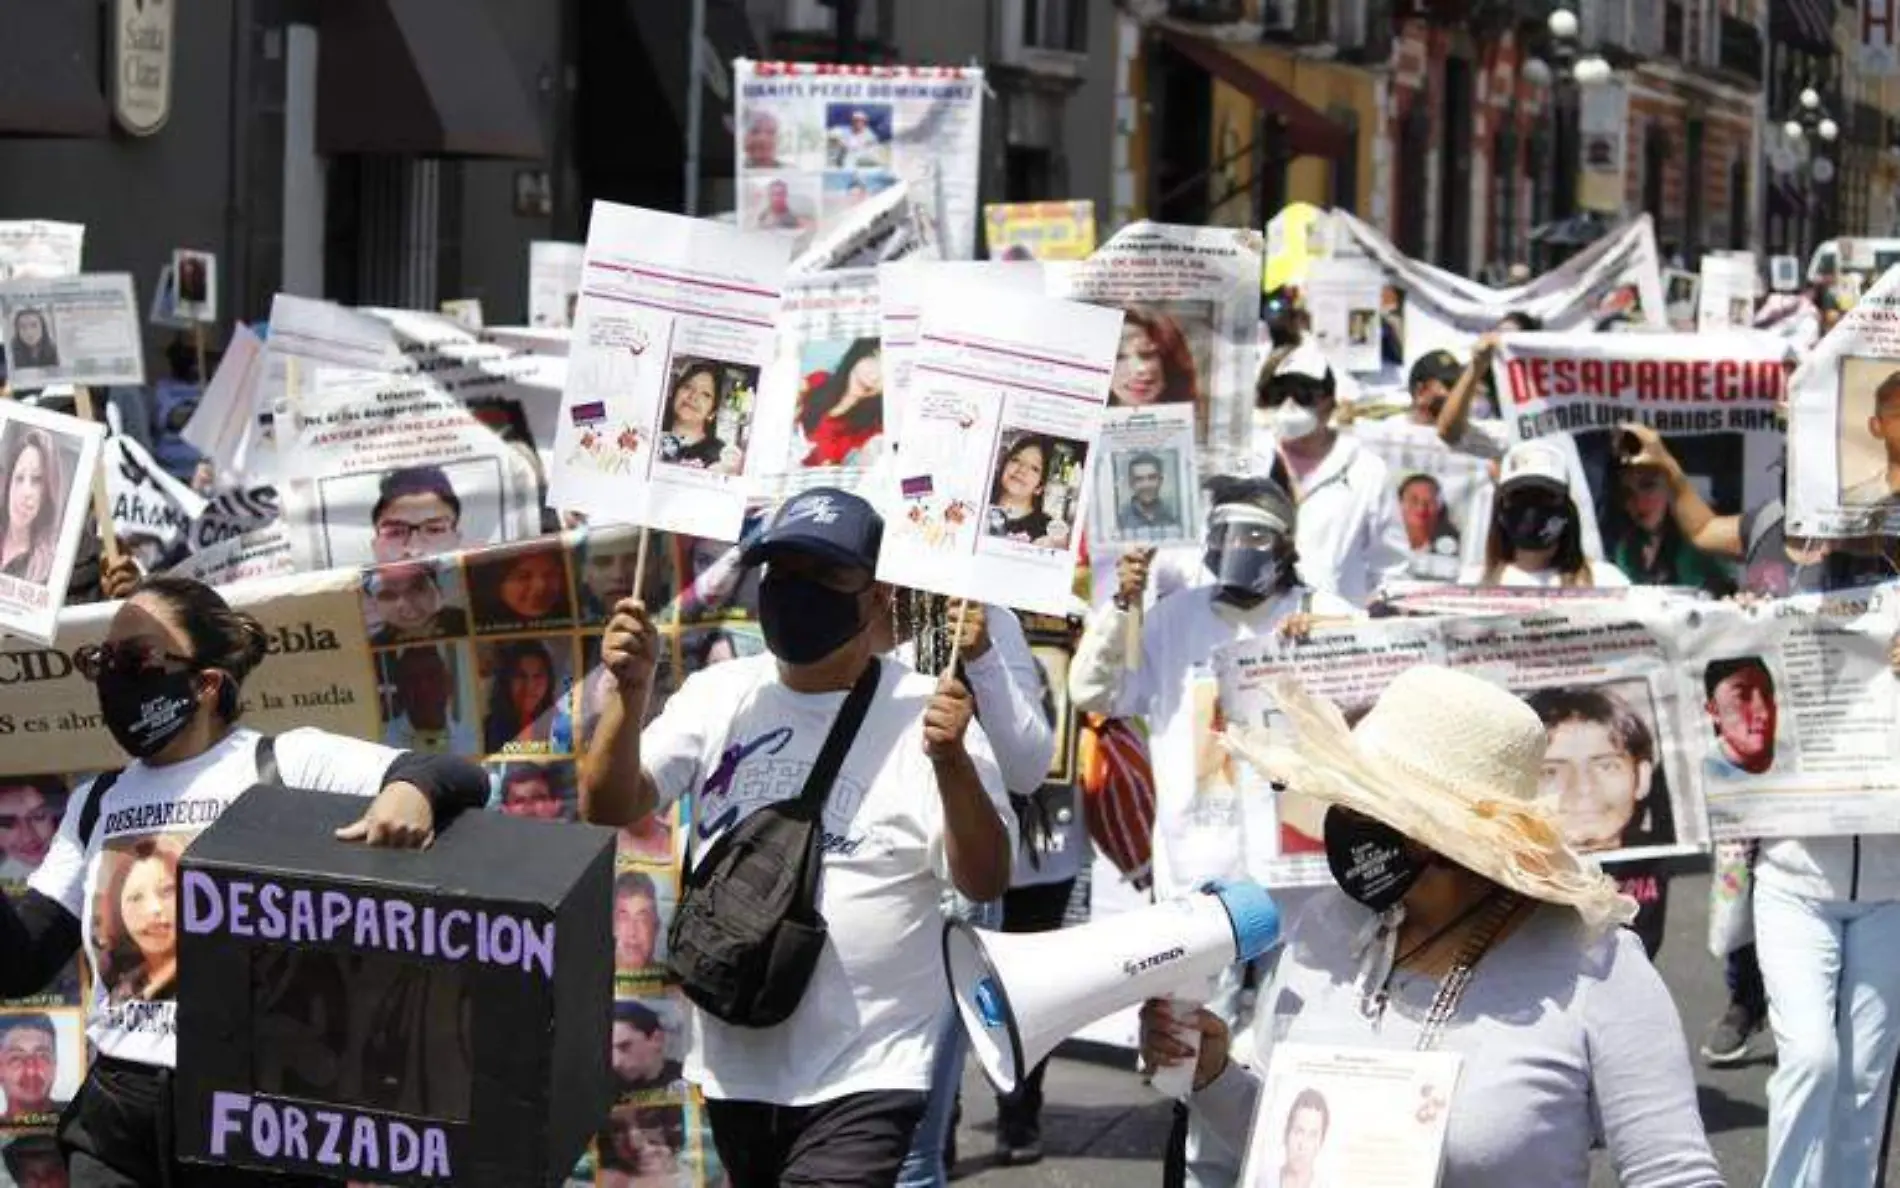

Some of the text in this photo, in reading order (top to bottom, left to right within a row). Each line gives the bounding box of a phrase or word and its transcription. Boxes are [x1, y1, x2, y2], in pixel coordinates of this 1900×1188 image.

[1643, 408, 1723, 432] LARIOS
[263, 621, 342, 654] ebla
[291, 683, 355, 707] nada
[24, 718, 51, 733] es
[57, 708, 104, 733] abr
[182, 869, 555, 979] DESAPARICION
[1138, 946, 1184, 970] STEREN
[209, 1090, 452, 1177] FORZADA
